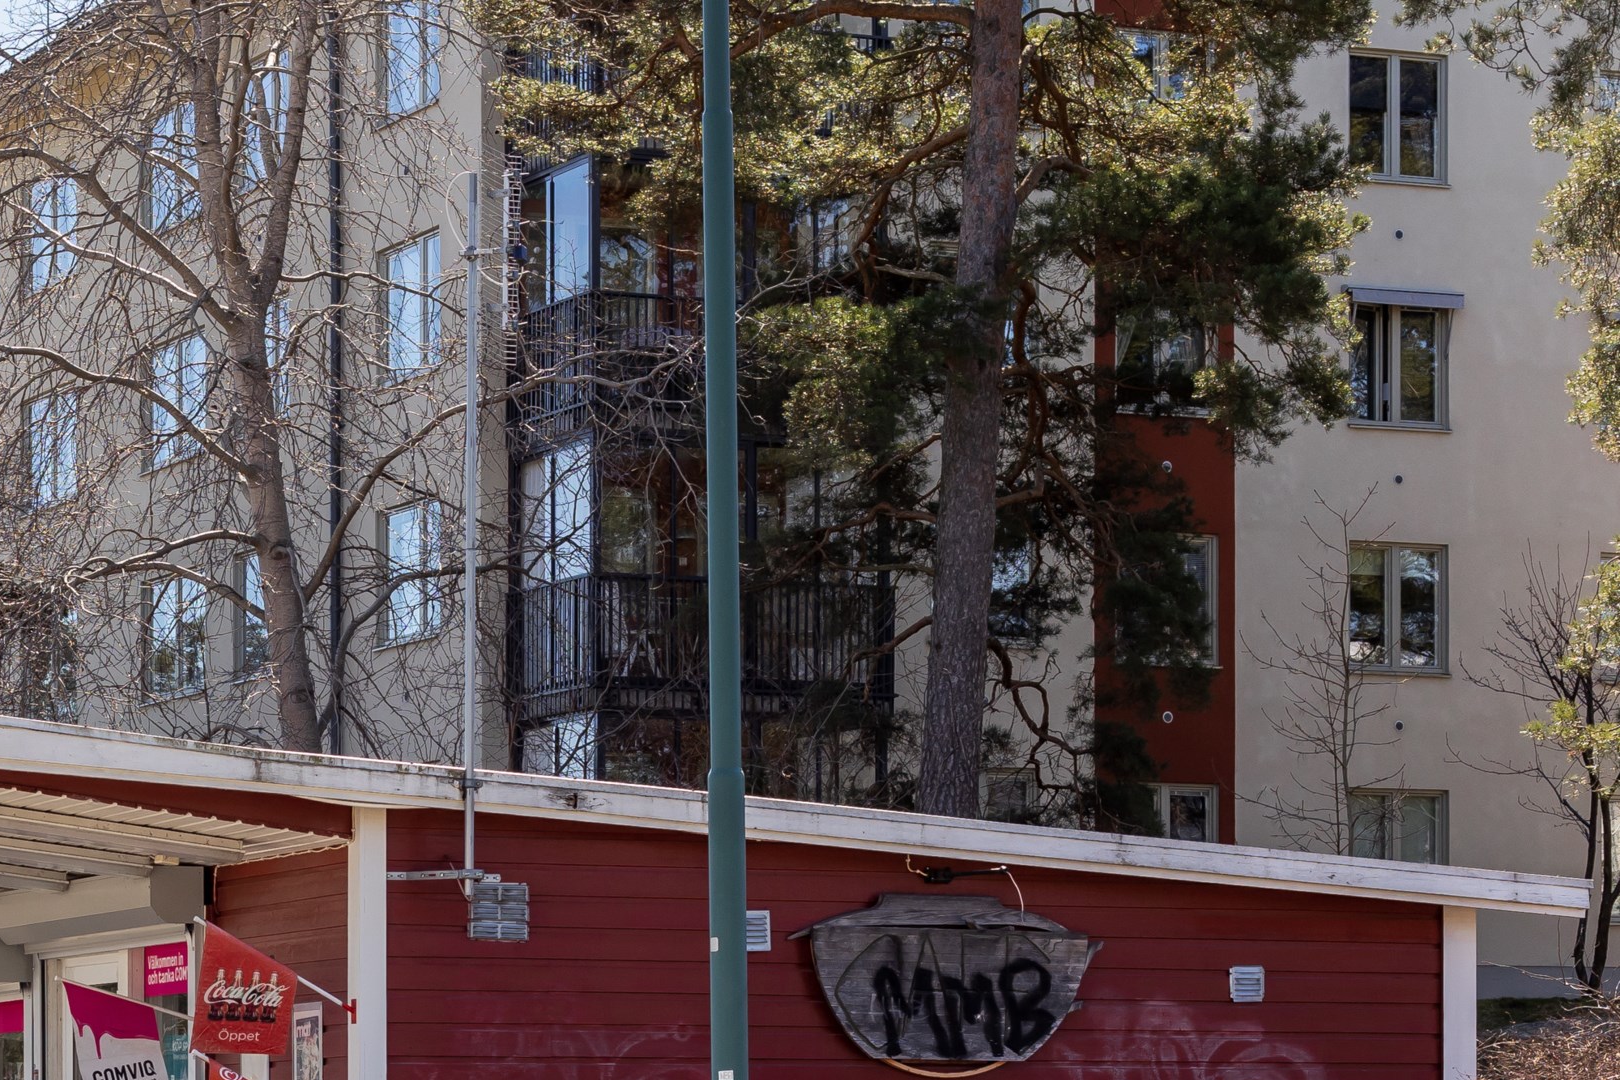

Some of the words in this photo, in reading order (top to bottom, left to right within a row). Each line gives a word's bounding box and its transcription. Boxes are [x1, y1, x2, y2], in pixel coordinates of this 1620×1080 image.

[147, 953, 178, 970] Välkommen
[178, 953, 184, 963] in
[148, 973, 158, 985] och
[158, 969, 175, 984] tanka
[203, 979, 290, 1008] Coca-Cola
[218, 1028, 260, 1042] Öppet
